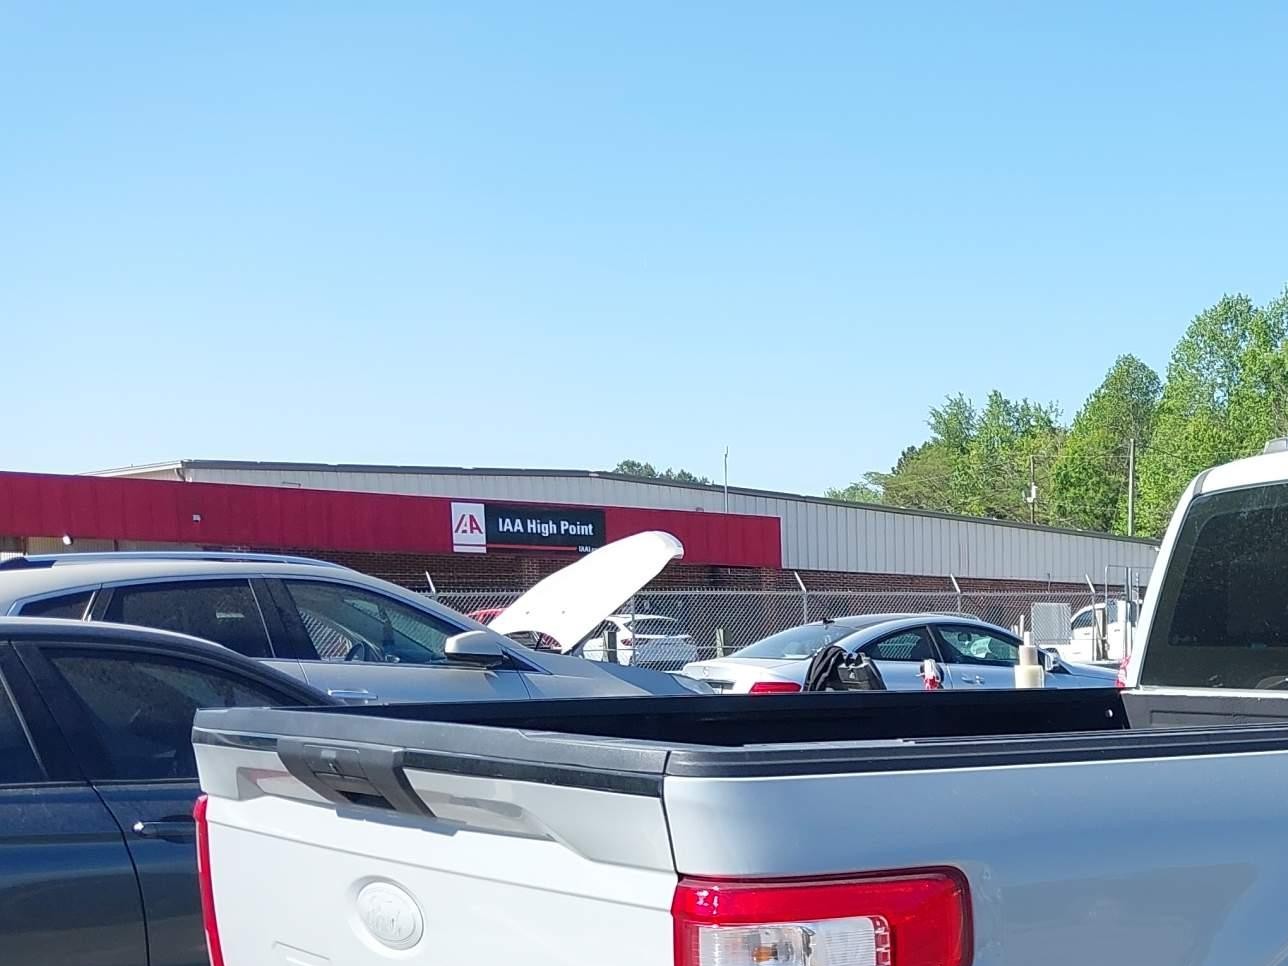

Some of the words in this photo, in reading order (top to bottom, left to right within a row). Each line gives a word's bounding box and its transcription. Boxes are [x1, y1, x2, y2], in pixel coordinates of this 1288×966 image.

[498, 518, 524, 533] IAA
[527, 519, 557, 536] High
[560, 521, 594, 536] Point
